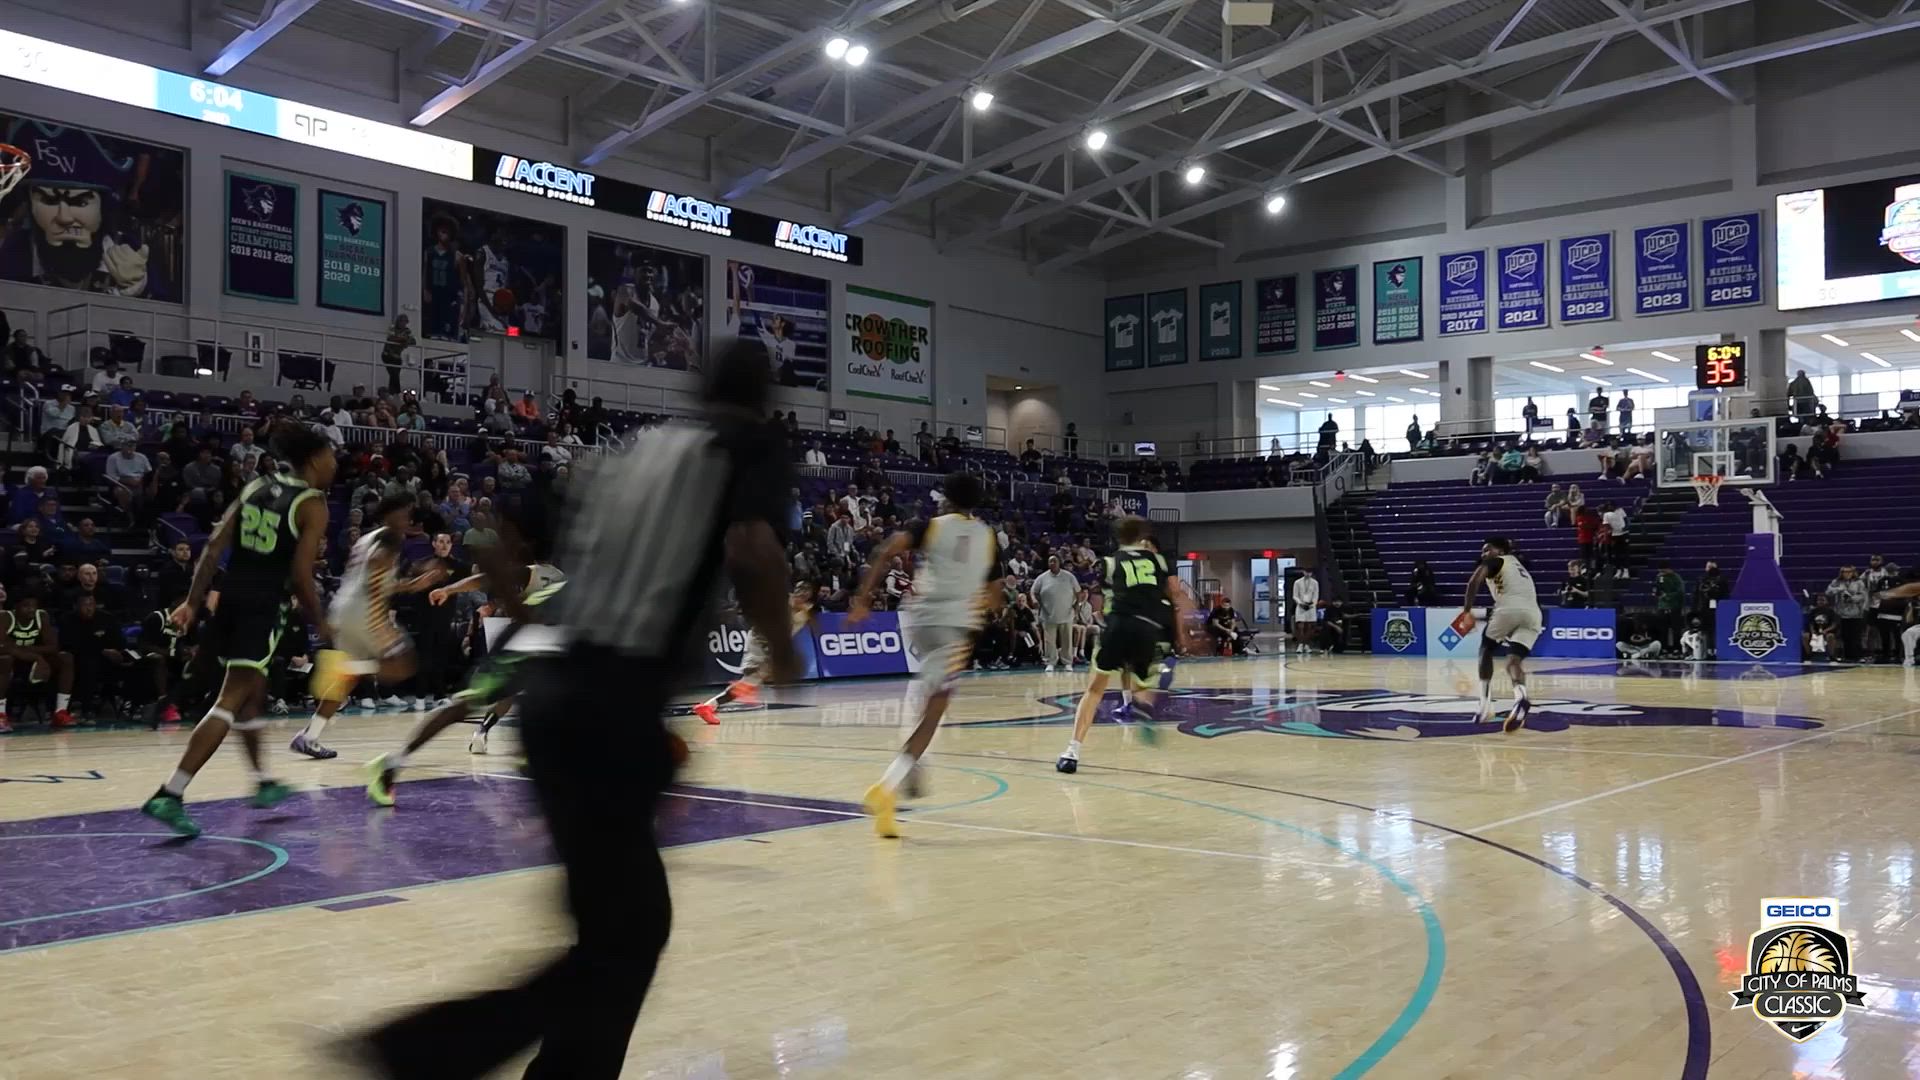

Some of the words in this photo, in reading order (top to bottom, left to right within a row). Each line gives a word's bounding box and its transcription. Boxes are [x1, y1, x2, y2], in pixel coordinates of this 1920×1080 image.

[189, 80, 244, 113] 6:04
[35, 138, 76, 174] FSW
[514, 159, 595, 197] ACCENT
[495, 176, 545, 196] business
[547, 187, 596, 207] products
[663, 195, 732, 228] ACCENT
[252, 221, 293, 234] BASKETBALL
[646, 209, 689, 228] business
[690, 220, 732, 237] products
[231, 233, 293, 252] CHAMPIONS
[789, 223, 849, 254] ACCENT
[1644, 232, 1679, 255] NJCAA
[1713, 223, 1750, 246] NJCAA
[231, 244, 252, 257] 2018
[273, 252, 294, 264] 2020
[774, 238, 811, 255] business
[812, 247, 849, 263] products
[1568, 243, 1602, 265] NJCAA
[323, 259, 351, 273] 2018
[353, 264, 381, 278] 2019
[1447, 258, 1478, 281] NJCAA
[1505, 252, 1537, 274] NJCAA
[1709, 263, 1754, 277] NATIONAL
[323, 270, 351, 283] 2020
[1637, 279, 1688, 293] CHAMPIONS
[1640, 271, 1684, 285] NATIONAL
[1502, 289, 1542, 301] NATIONAL
[1562, 288, 1609, 302] CHAMPIONS
[1565, 281, 1605, 293] NATIONAL
[1711, 285, 1753, 302] 2025
[1446, 293, 1480, 304] NATIONAL
[1500, 297, 1544, 309] CHAMPIONS
[1642, 292, 1683, 309] 2023
[1458, 308, 1484, 319] PLACE
[1504, 309, 1538, 324] 2021
[1566, 302, 1605, 316] 2022
[845, 313, 929, 346] CROWTHER
[1446, 318, 1479, 333] 2017
[851, 335, 921, 363] ROOFING
[1707, 345, 1741, 361] 6:04
[1706, 360, 1735, 384] 35
[240, 503, 281, 555] 25
[1119, 558, 1158, 588] 12
[1551, 627, 1614, 641] GEICO
[819, 631, 901, 657] GEICO
